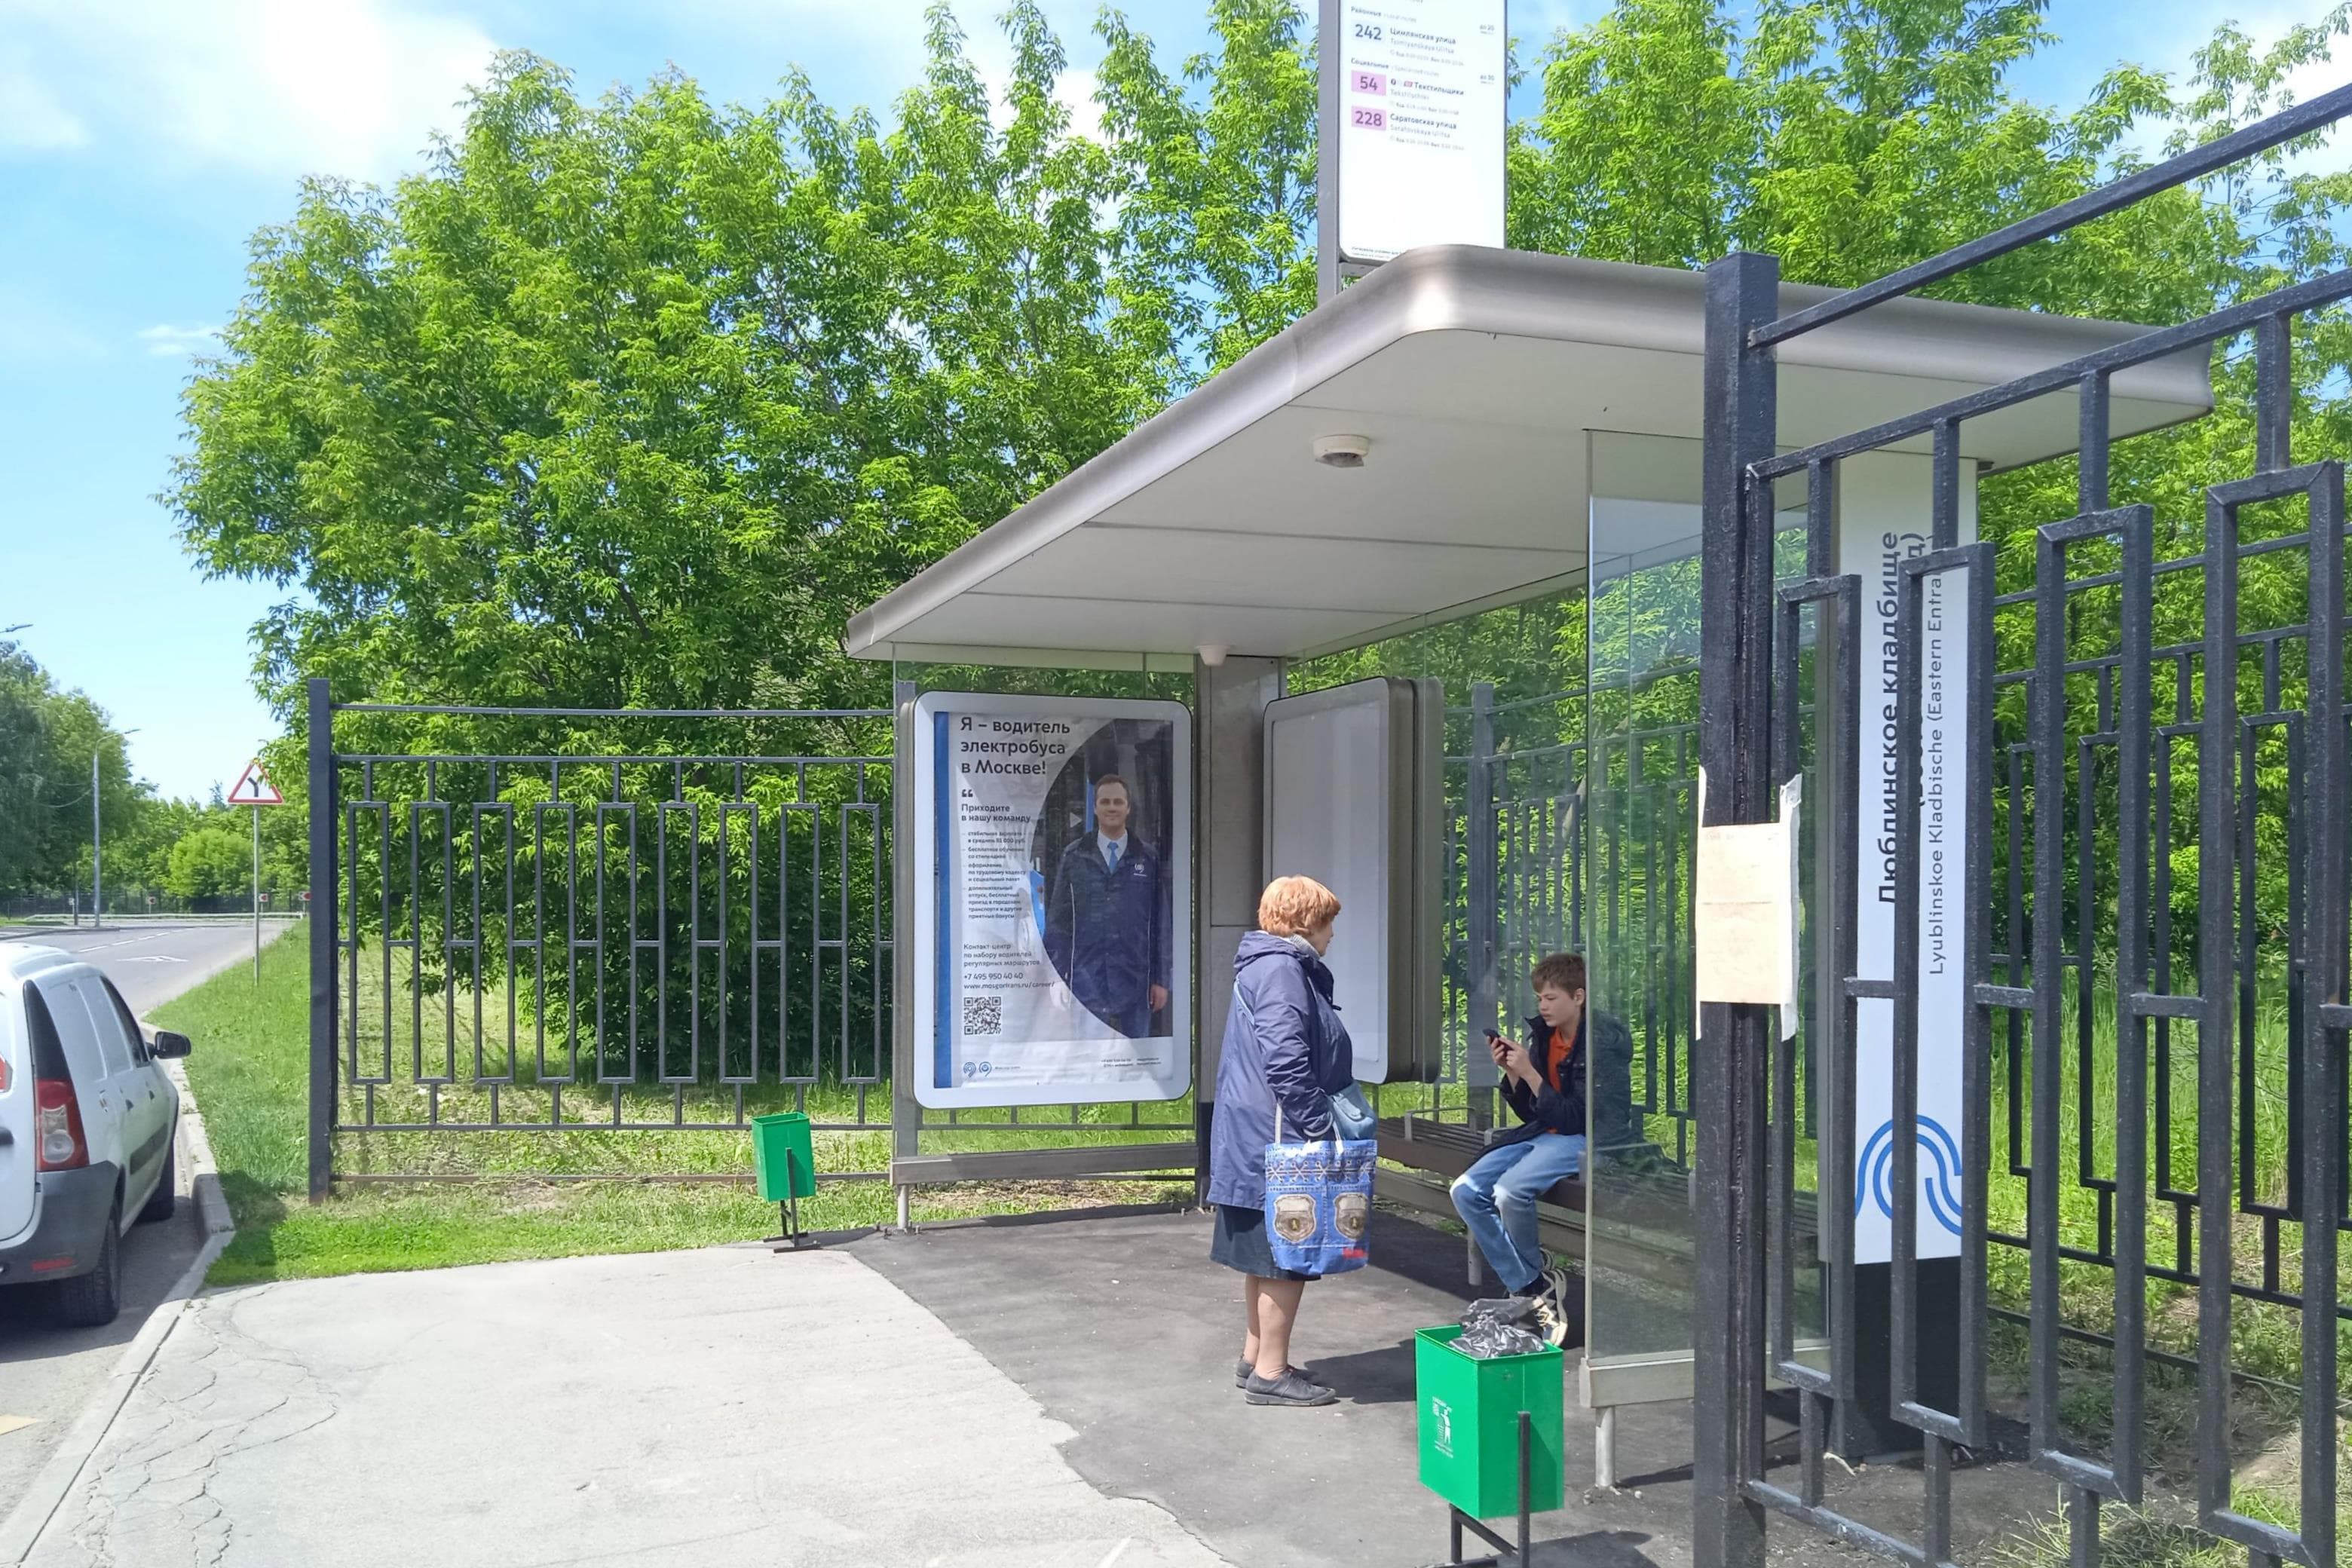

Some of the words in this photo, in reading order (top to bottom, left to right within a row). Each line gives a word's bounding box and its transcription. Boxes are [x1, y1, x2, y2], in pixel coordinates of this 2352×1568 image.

[1355, 24, 1382, 40] 242
[1435, 35, 1456, 44] улица
[1360, 76, 1378, 90] 54
[1355, 111, 1382, 127] 228
[1390, 113, 1434, 126] Саратовская
[1435, 121, 1456, 130] улица
[1928, 571, 1942, 632] Entra
[1876, 532, 1900, 694] кладбище
[1926, 639, 1943, 721] (Eastern
[960, 717, 972, 731] Я
[993, 721, 1070, 735] водитель
[960, 740, 1066, 757] электробуса
[961, 763, 971, 773] в
[975, 759, 1046, 775] Москве!
[1928, 728, 1943, 844] Kladbische
[961, 804, 1010, 813] Приходите
[1877, 704, 1897, 904] Люблинское
[969, 815, 991, 823] нашу
[993, 816, 1031, 824] команду
[1928, 851, 1946, 975] Lyublinskoe
